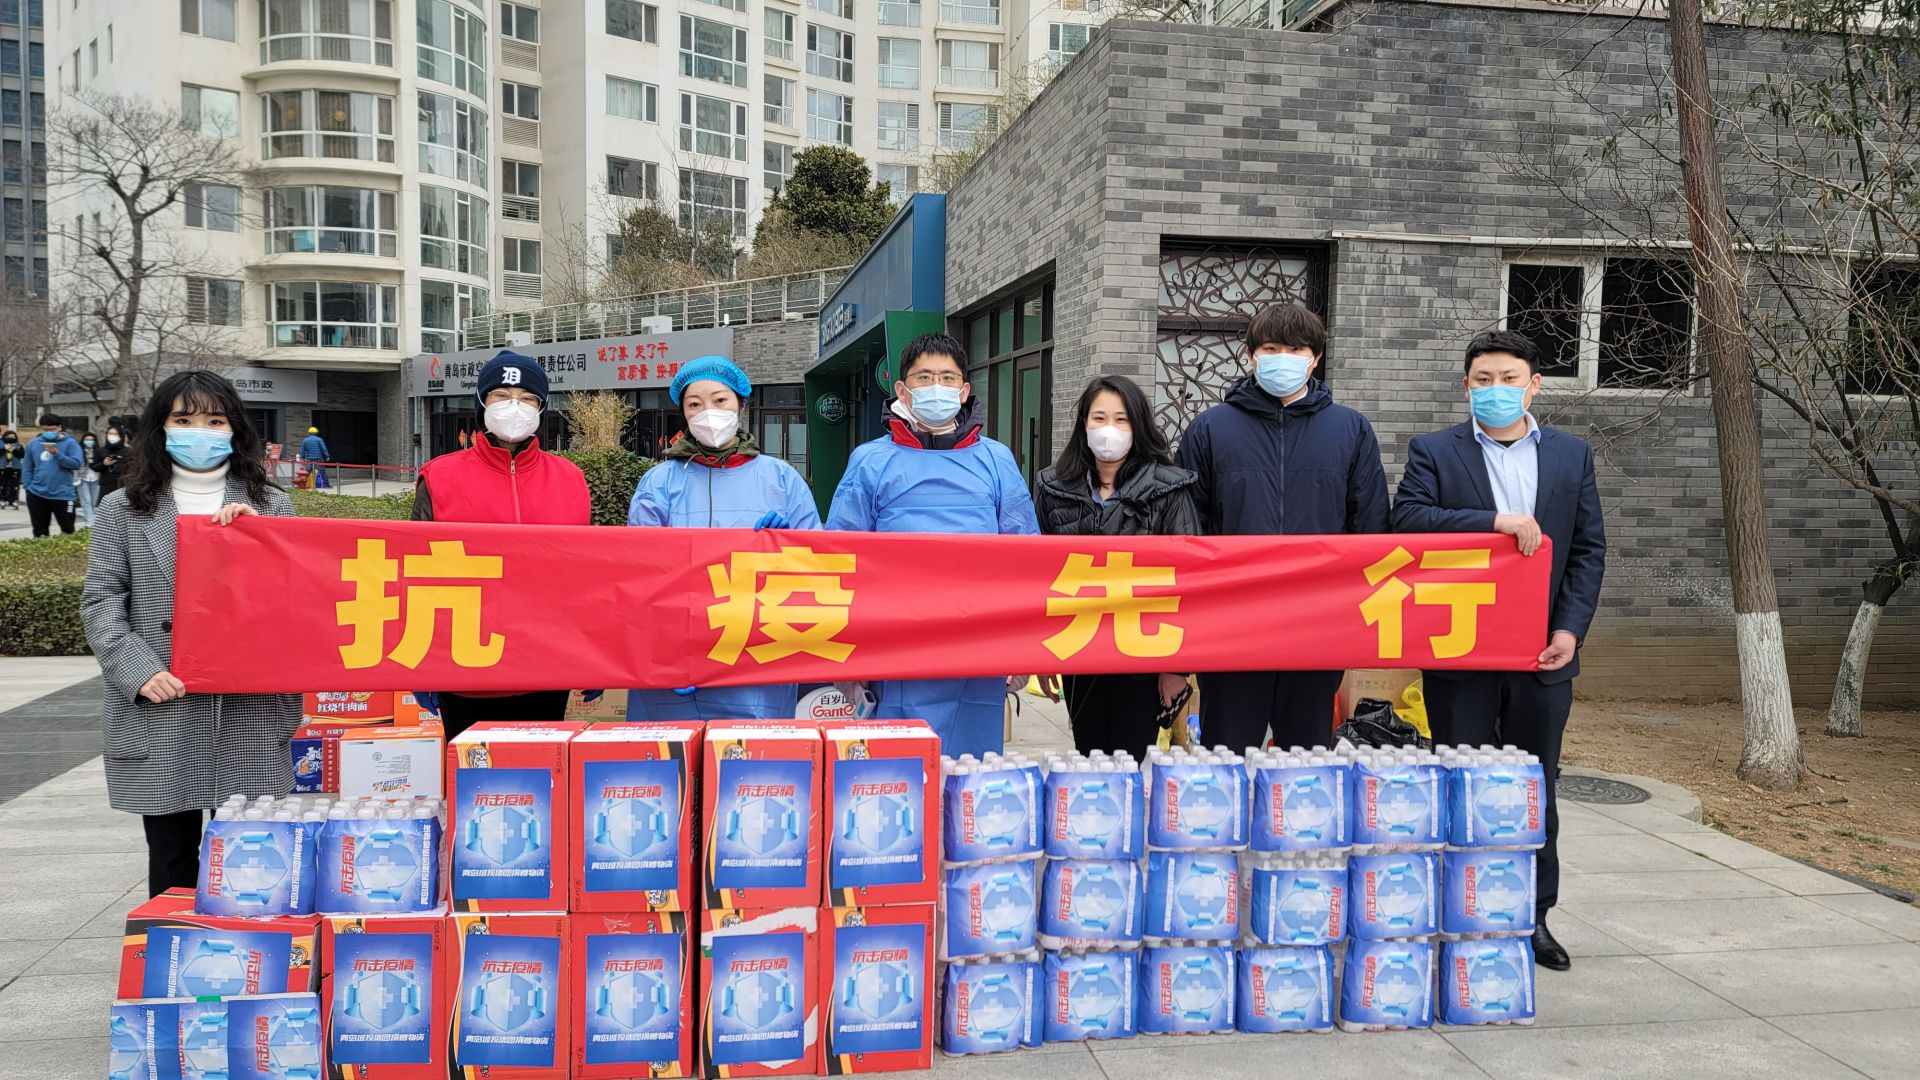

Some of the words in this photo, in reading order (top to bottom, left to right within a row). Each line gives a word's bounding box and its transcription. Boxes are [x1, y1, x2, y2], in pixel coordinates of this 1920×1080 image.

[231, 379, 273, 389] 岛市政
[501, 366, 522, 386] D
[534, 353, 587, 373] 限责任公司
[335, 538, 1497, 670] 抗疫先行
[317, 702, 368, 713] 红烧牛肉面
[473, 793, 535, 807] 抗击疫情
[602, 785, 662, 799] 抗击疫情
[737, 784, 795, 797] 抗击疫情
[851, 782, 909, 796] 抗击疫情
[1055, 786, 1068, 841] 抗击疫情
[1166, 779, 1179, 832] 抗击疫情
[1272, 783, 1284, 836] 抗击疫情
[1366, 777, 1378, 829] 抗击疫情
[1526, 778, 1540, 831] 抗击疫情
[962, 790, 975, 844] 抗击疫情
[208, 837, 225, 896] 抗击疫情
[340, 834, 356, 894] 抗击疫情
[969, 882, 982, 938] 抗击疫情
[1058, 866, 1072, 922] 抗击疫情
[1226, 871, 1239, 925] 抗击疫情
[1328, 885, 1342, 939] 抗击疫情
[1366, 870, 1377, 922] 抗击疫情
[1465, 864, 1476, 918] 抗击疫情
[353, 958, 416, 972] 抗击疫情
[481, 960, 544, 974] 抗击疫情
[604, 958, 664, 972] 抗击疫情
[730, 957, 790, 973] 抗击疫情
[851, 948, 910, 963] 抗击疫情
[1361, 955, 1376, 1008] 抗击疫情
[1057, 969, 1070, 1024] 抗击疫情
[1160, 962, 1171, 1016] 抗击疫情
[1251, 964, 1266, 1017] 抗击疫情
[1455, 957, 1471, 1008] 抗击疫情
[956, 982, 969, 1038] 抗击疫情
[255, 1015, 270, 1072] 抗击疫情
